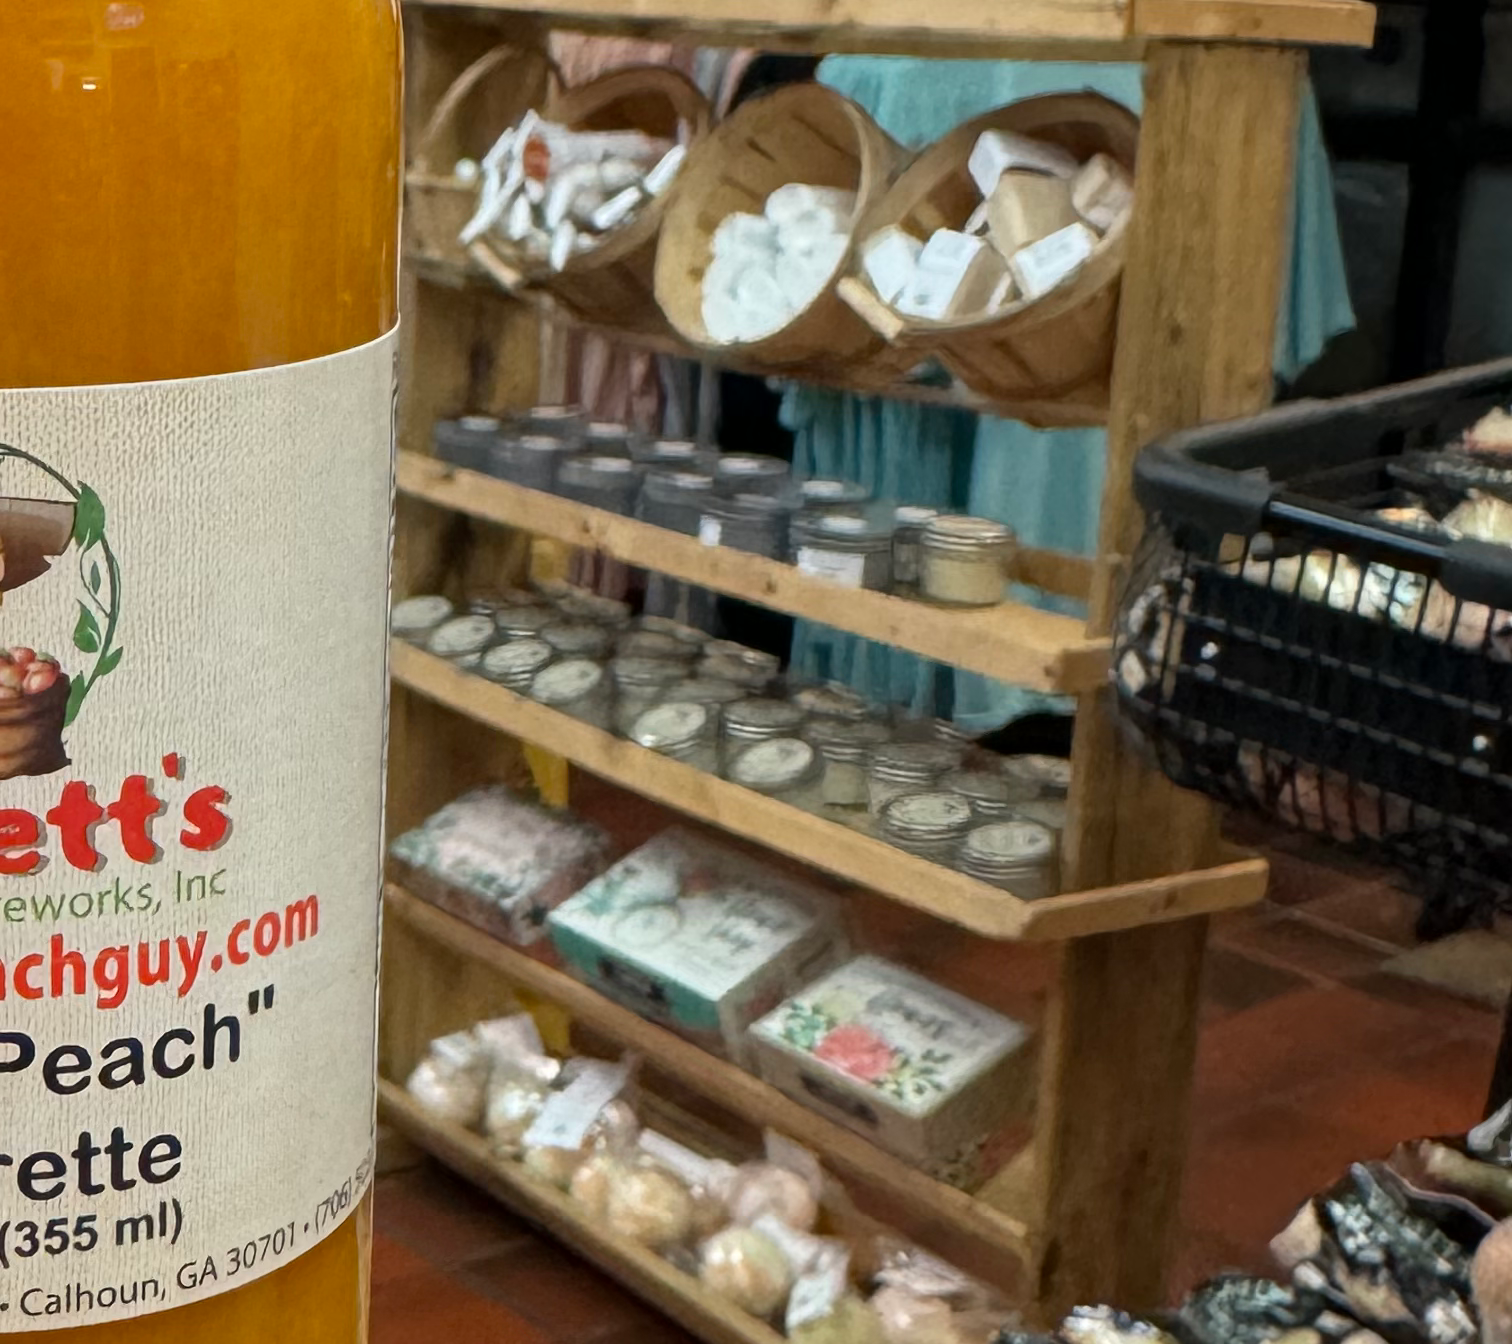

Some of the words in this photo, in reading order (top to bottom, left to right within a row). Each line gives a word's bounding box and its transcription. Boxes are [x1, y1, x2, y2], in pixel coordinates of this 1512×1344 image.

[174, 867, 227, 904] Inc
[19, 1275, 168, 1320] Calhoun,
[176, 1255, 219, 1291] GA
[226, 1220, 295, 1276] 30701
[314, 1176, 352, 1236] (706)
[114, 1196, 184, 1249] ml)
